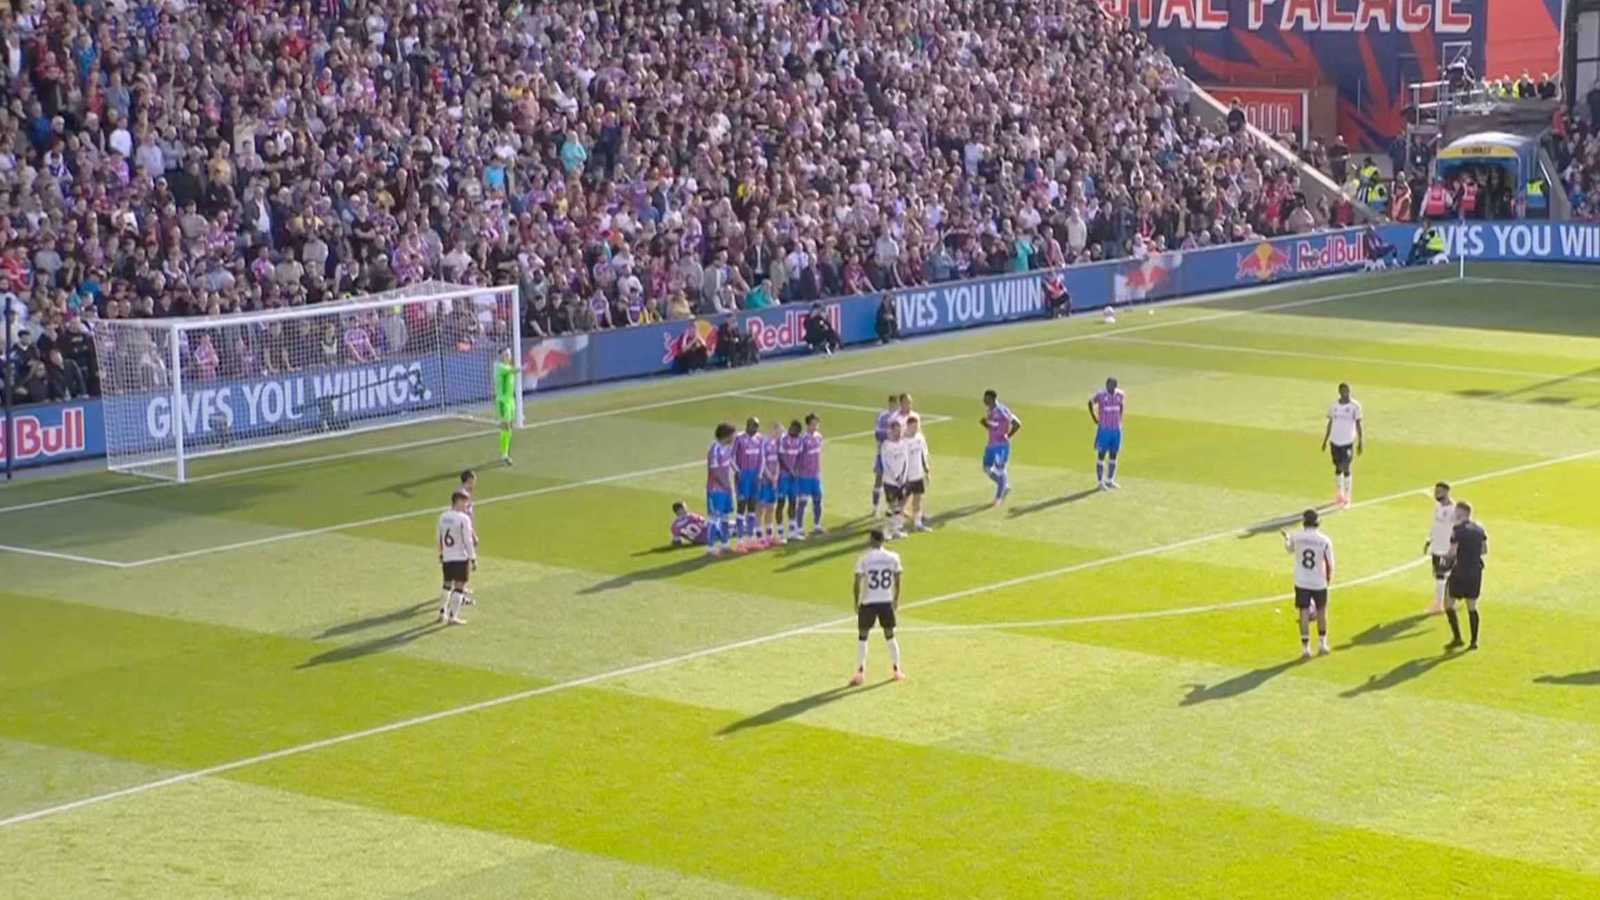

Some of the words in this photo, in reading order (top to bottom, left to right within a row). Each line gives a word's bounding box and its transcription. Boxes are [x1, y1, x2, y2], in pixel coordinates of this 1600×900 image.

[1493, 225, 1550, 256] YOU
[944, 284, 986, 322] YOU
[746, 310, 795, 352] Red
[243, 376, 304, 426] YOU
[13, 406, 85, 459] Bull
[444, 528, 455, 547] 6
[1302, 548, 1316, 570] 8
[867, 569, 893, 590] 38
